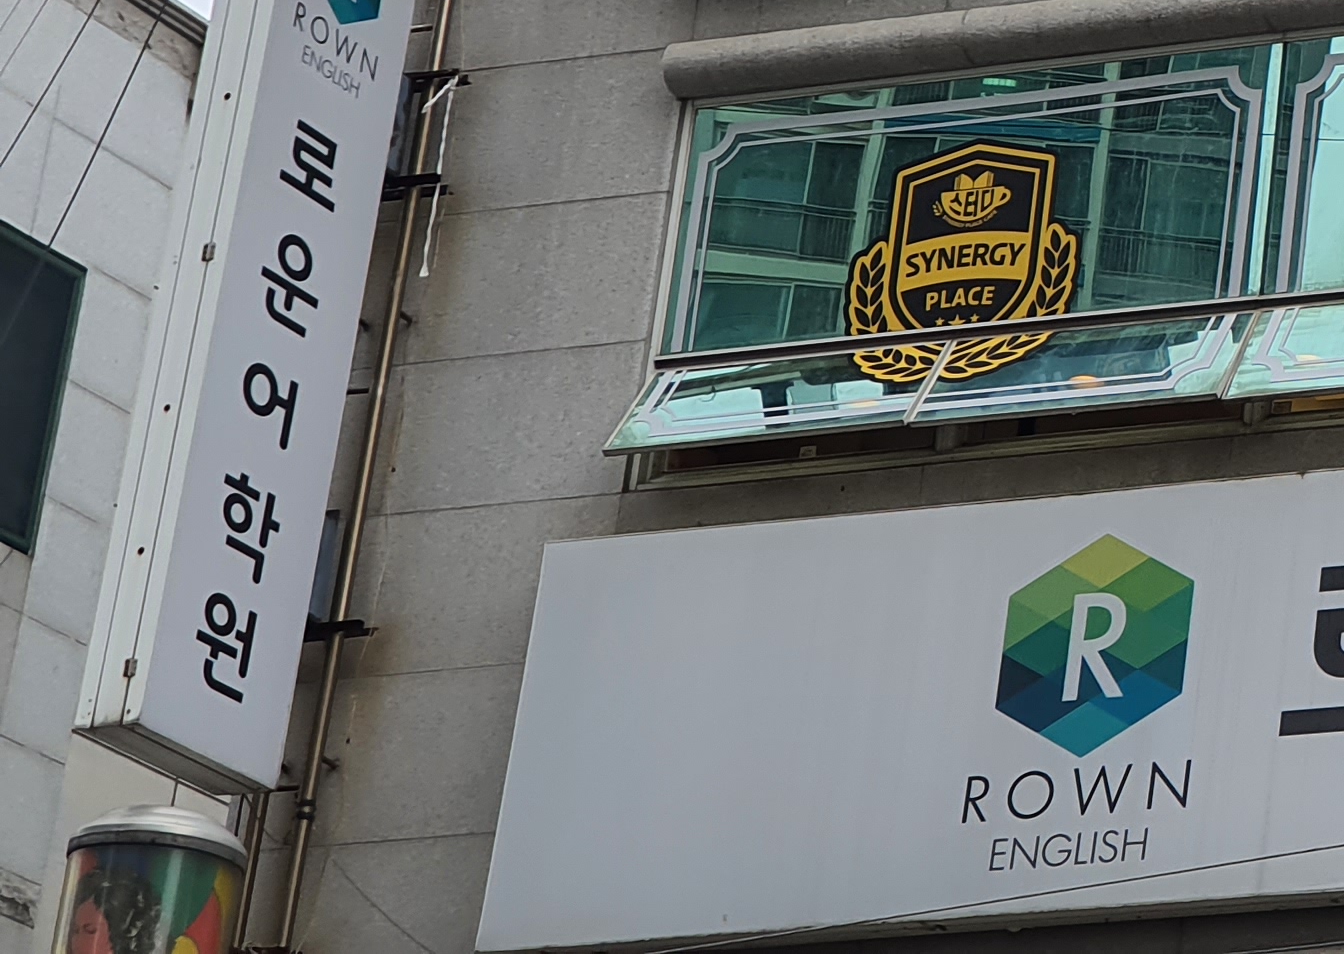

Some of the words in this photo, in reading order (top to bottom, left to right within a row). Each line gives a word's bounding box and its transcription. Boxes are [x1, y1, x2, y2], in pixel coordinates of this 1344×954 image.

[293, 1, 379, 81] ROWN
[301, 46, 361, 99] ENGLISH
[905, 242, 1026, 278] SYNERGY
[925, 286, 996, 311] PLACE
[197, 119, 338, 703] 로운어학원
[1061, 591, 1127, 702] R
[960, 759, 1193, 825] ROWN
[988, 827, 1150, 872] ENGLISH
